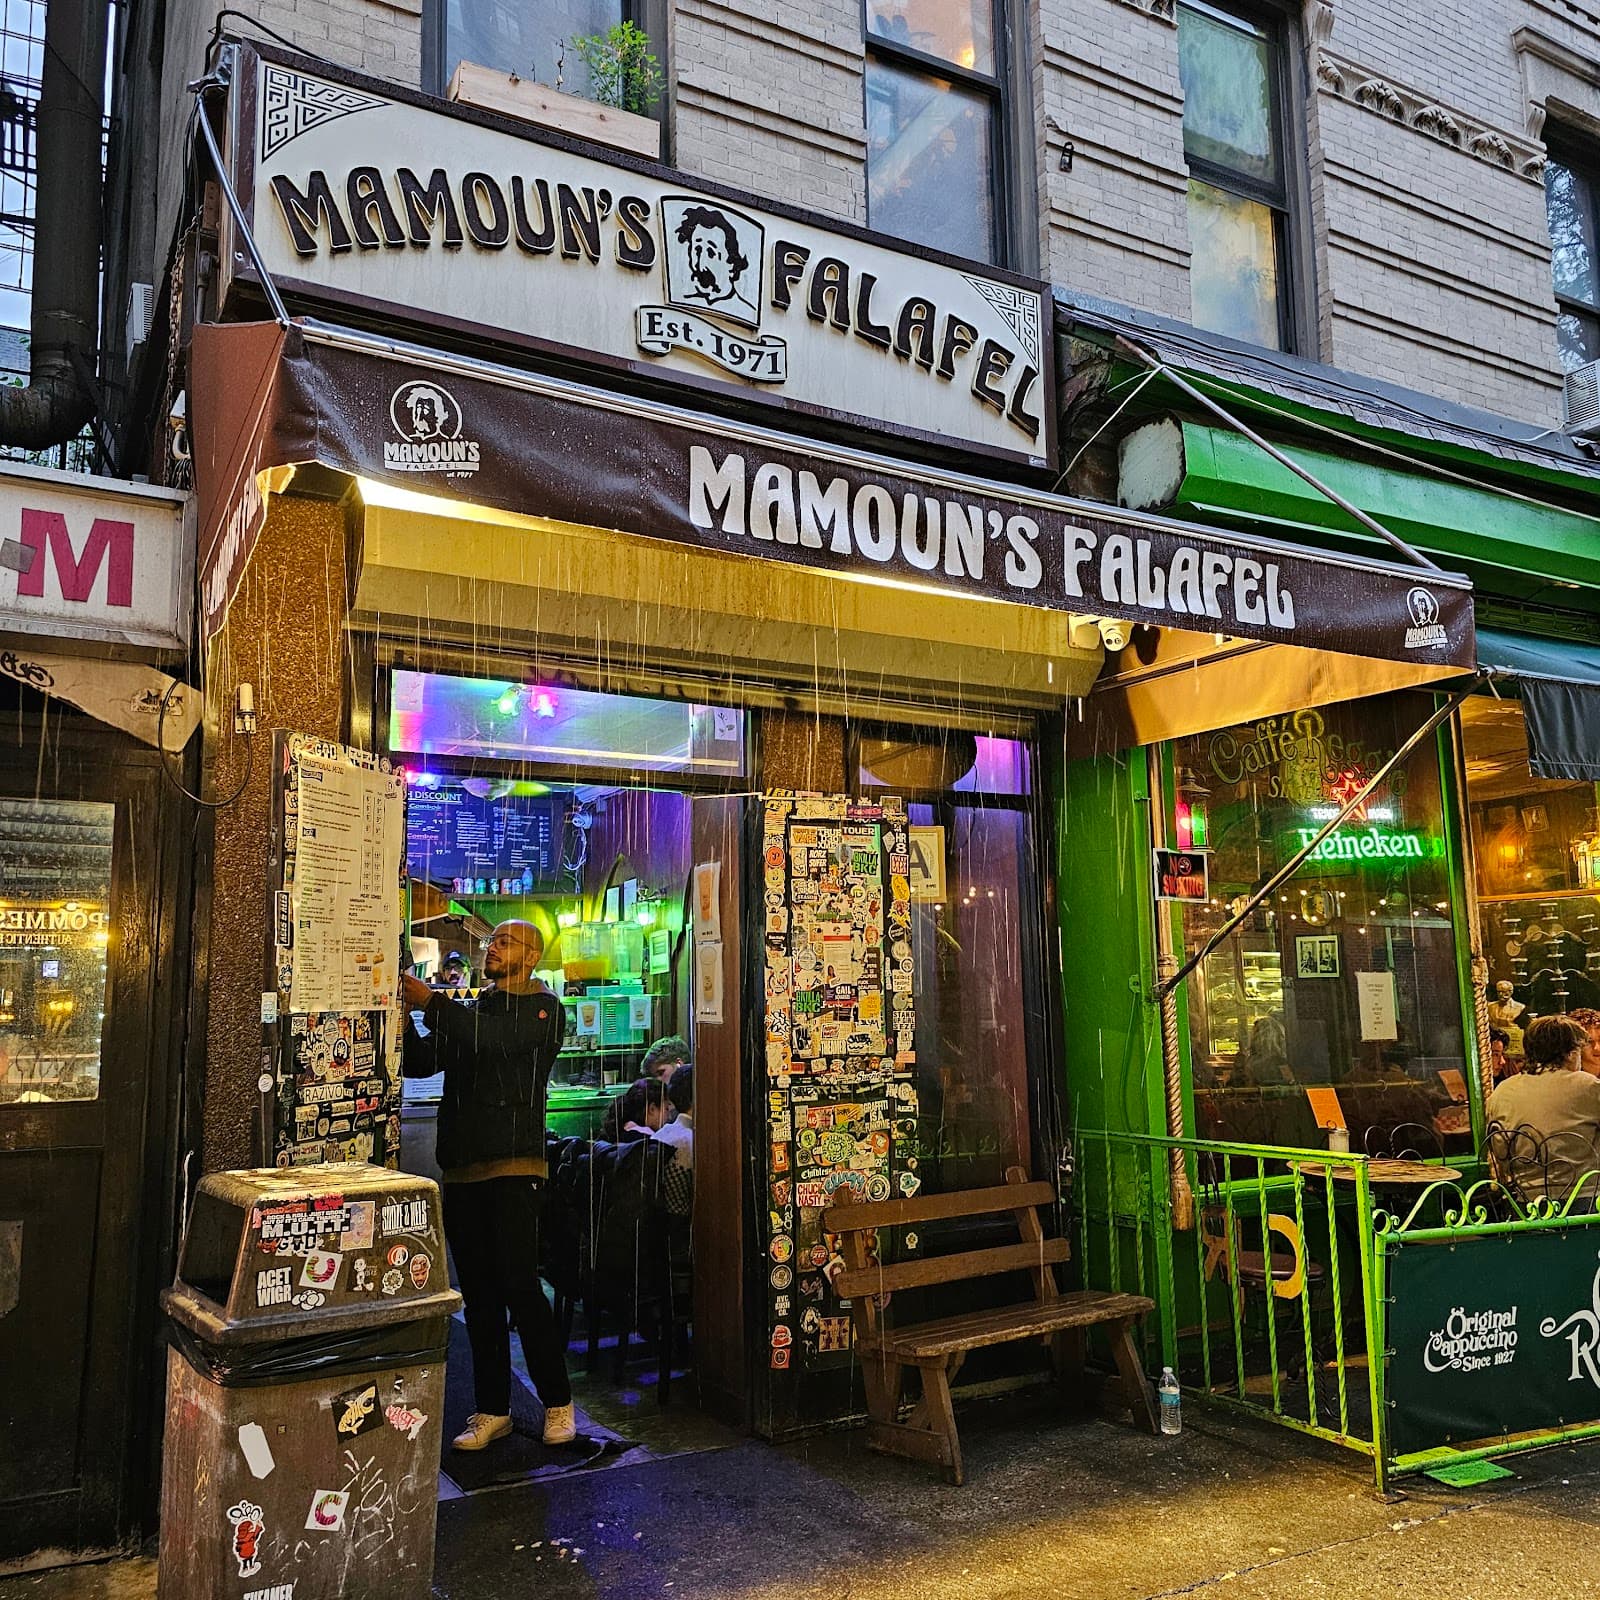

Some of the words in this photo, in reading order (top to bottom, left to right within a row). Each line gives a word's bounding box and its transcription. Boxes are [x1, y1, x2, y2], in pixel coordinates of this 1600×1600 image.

[270, 166, 657, 271] MAMOUN'S
[771, 240, 1039, 440] FALAFEL
[647, 312, 704, 347] Est.
[711, 333, 782, 376] 1971
[384, 441, 480, 462] MAMOUN'S
[690, 446, 1042, 589] MAMOUN'S
[1063, 525, 1296, 630] FALAFEL
[17, 508, 135, 608] M
[1406, 624, 1446, 642] MAMOUN'S
[415, 791, 462, 801] DISCOUNT
[1163, 873, 1205, 897] SMOKING
[262, 1218, 350, 1239] M.U.T.T.
[1447, 1306, 1517, 1339] Original
[1424, 1329, 1518, 1372] Cappuccino
[1462, 1356, 1491, 1371] Since
[1494, 1350, 1515, 1365] 1927
